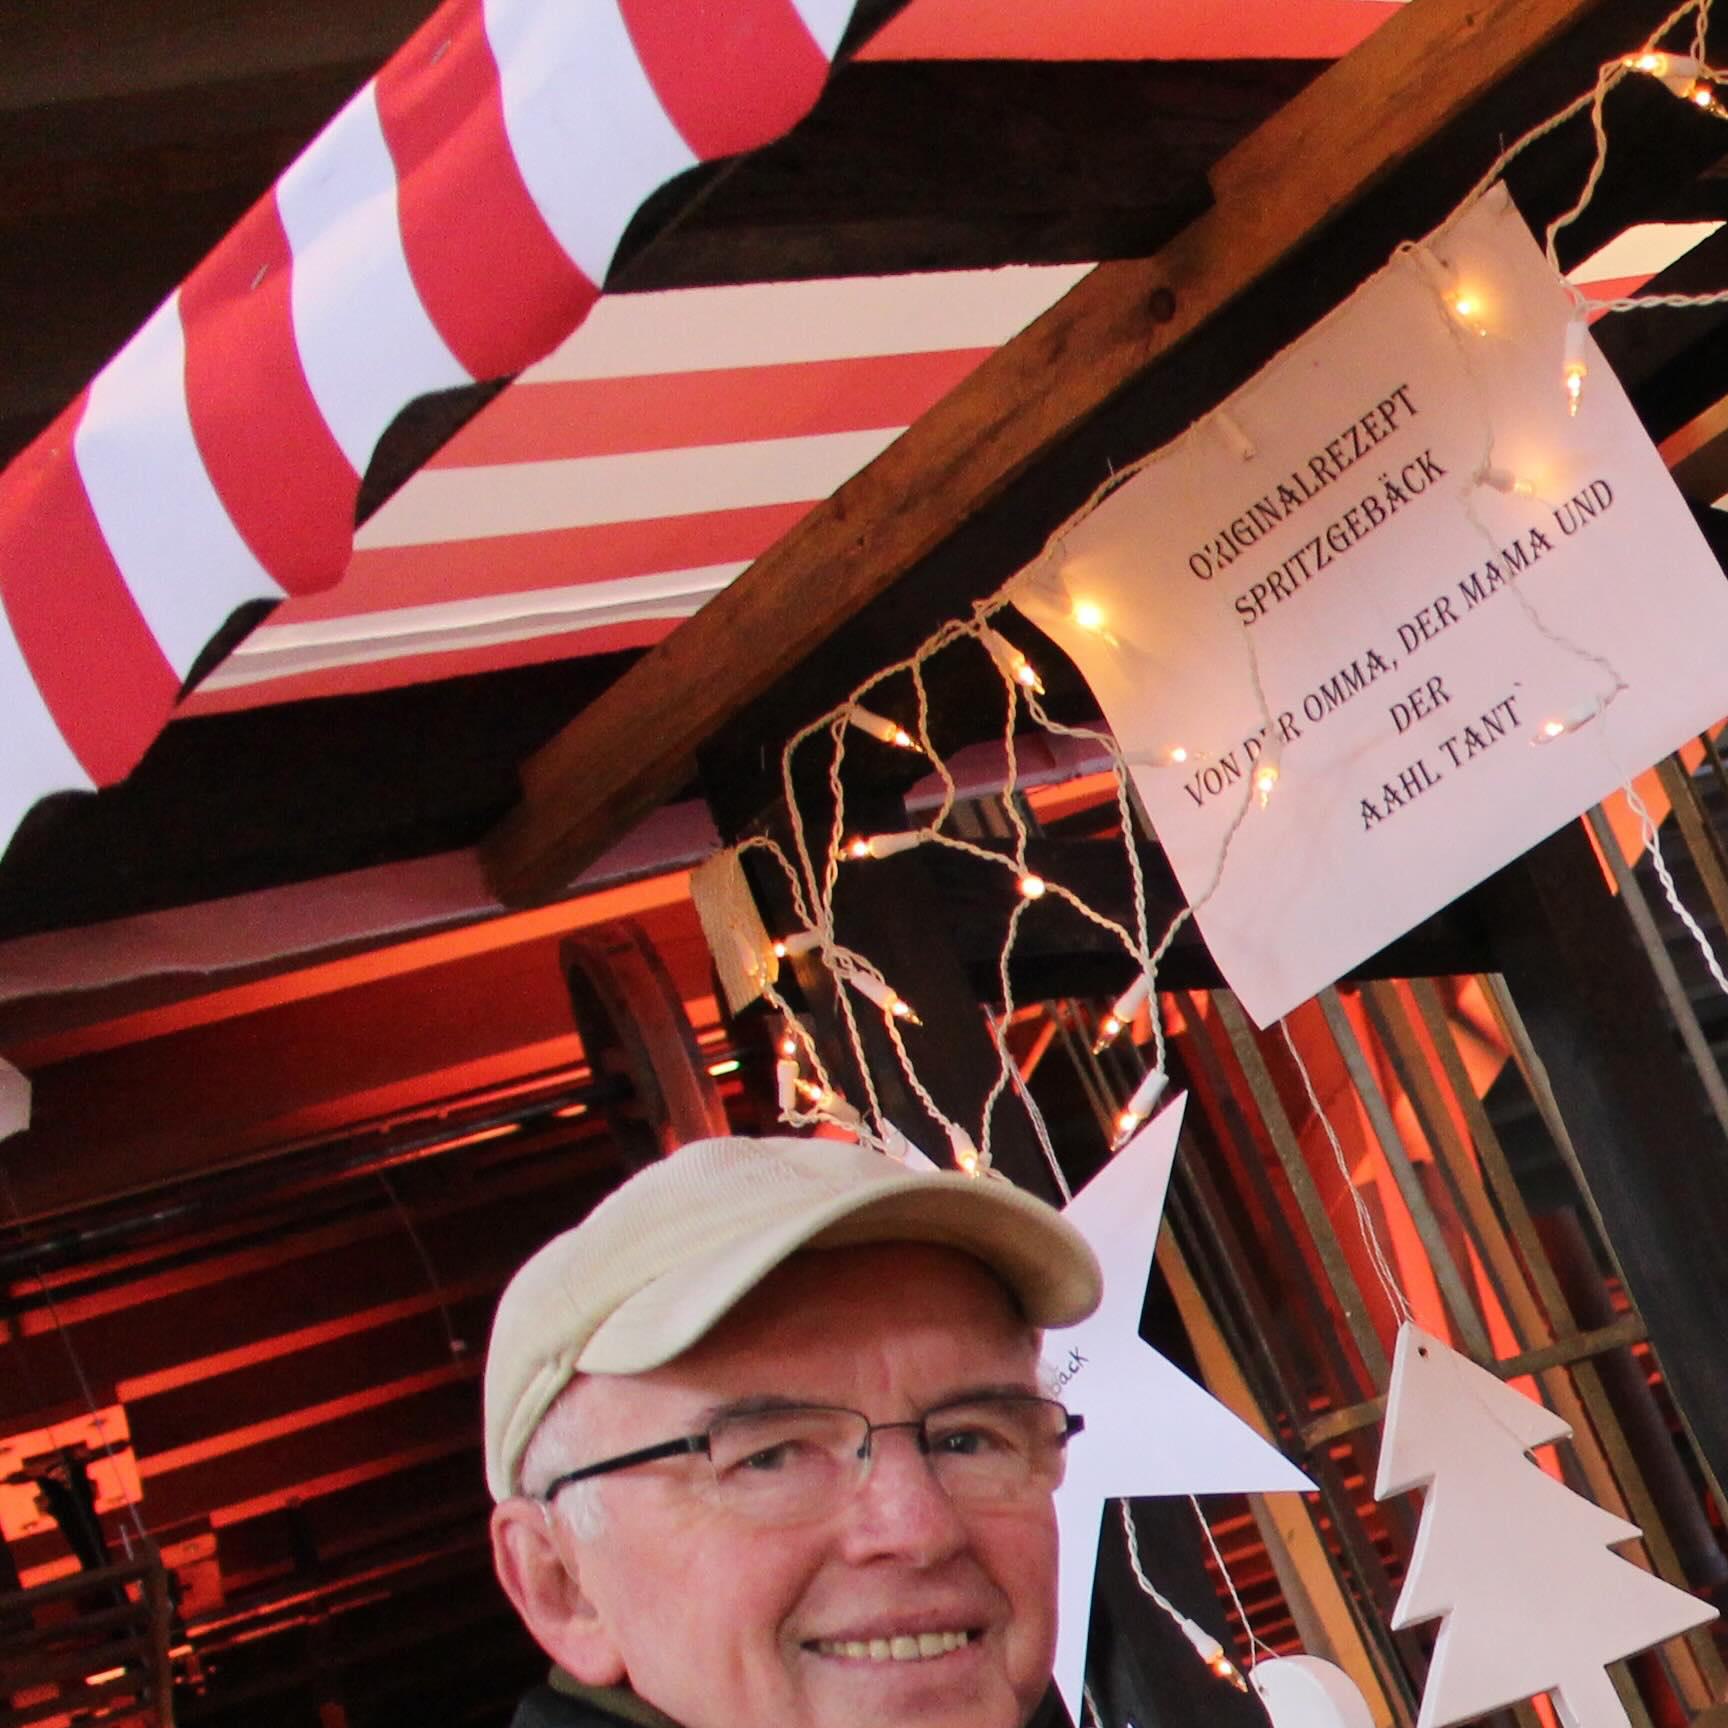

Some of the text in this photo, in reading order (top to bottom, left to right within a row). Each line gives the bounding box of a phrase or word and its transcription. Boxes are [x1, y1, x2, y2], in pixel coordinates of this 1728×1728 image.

[1189, 384, 1418, 580] ORIGINALREZEPT
[1235, 450, 1447, 626] SPRITZGEBÄCK
[1184, 479, 1614, 808] VON DR OMMA, DER MAMA UND
[1389, 676, 1452, 735] DER
[1360, 760, 1443, 831] AAHL
